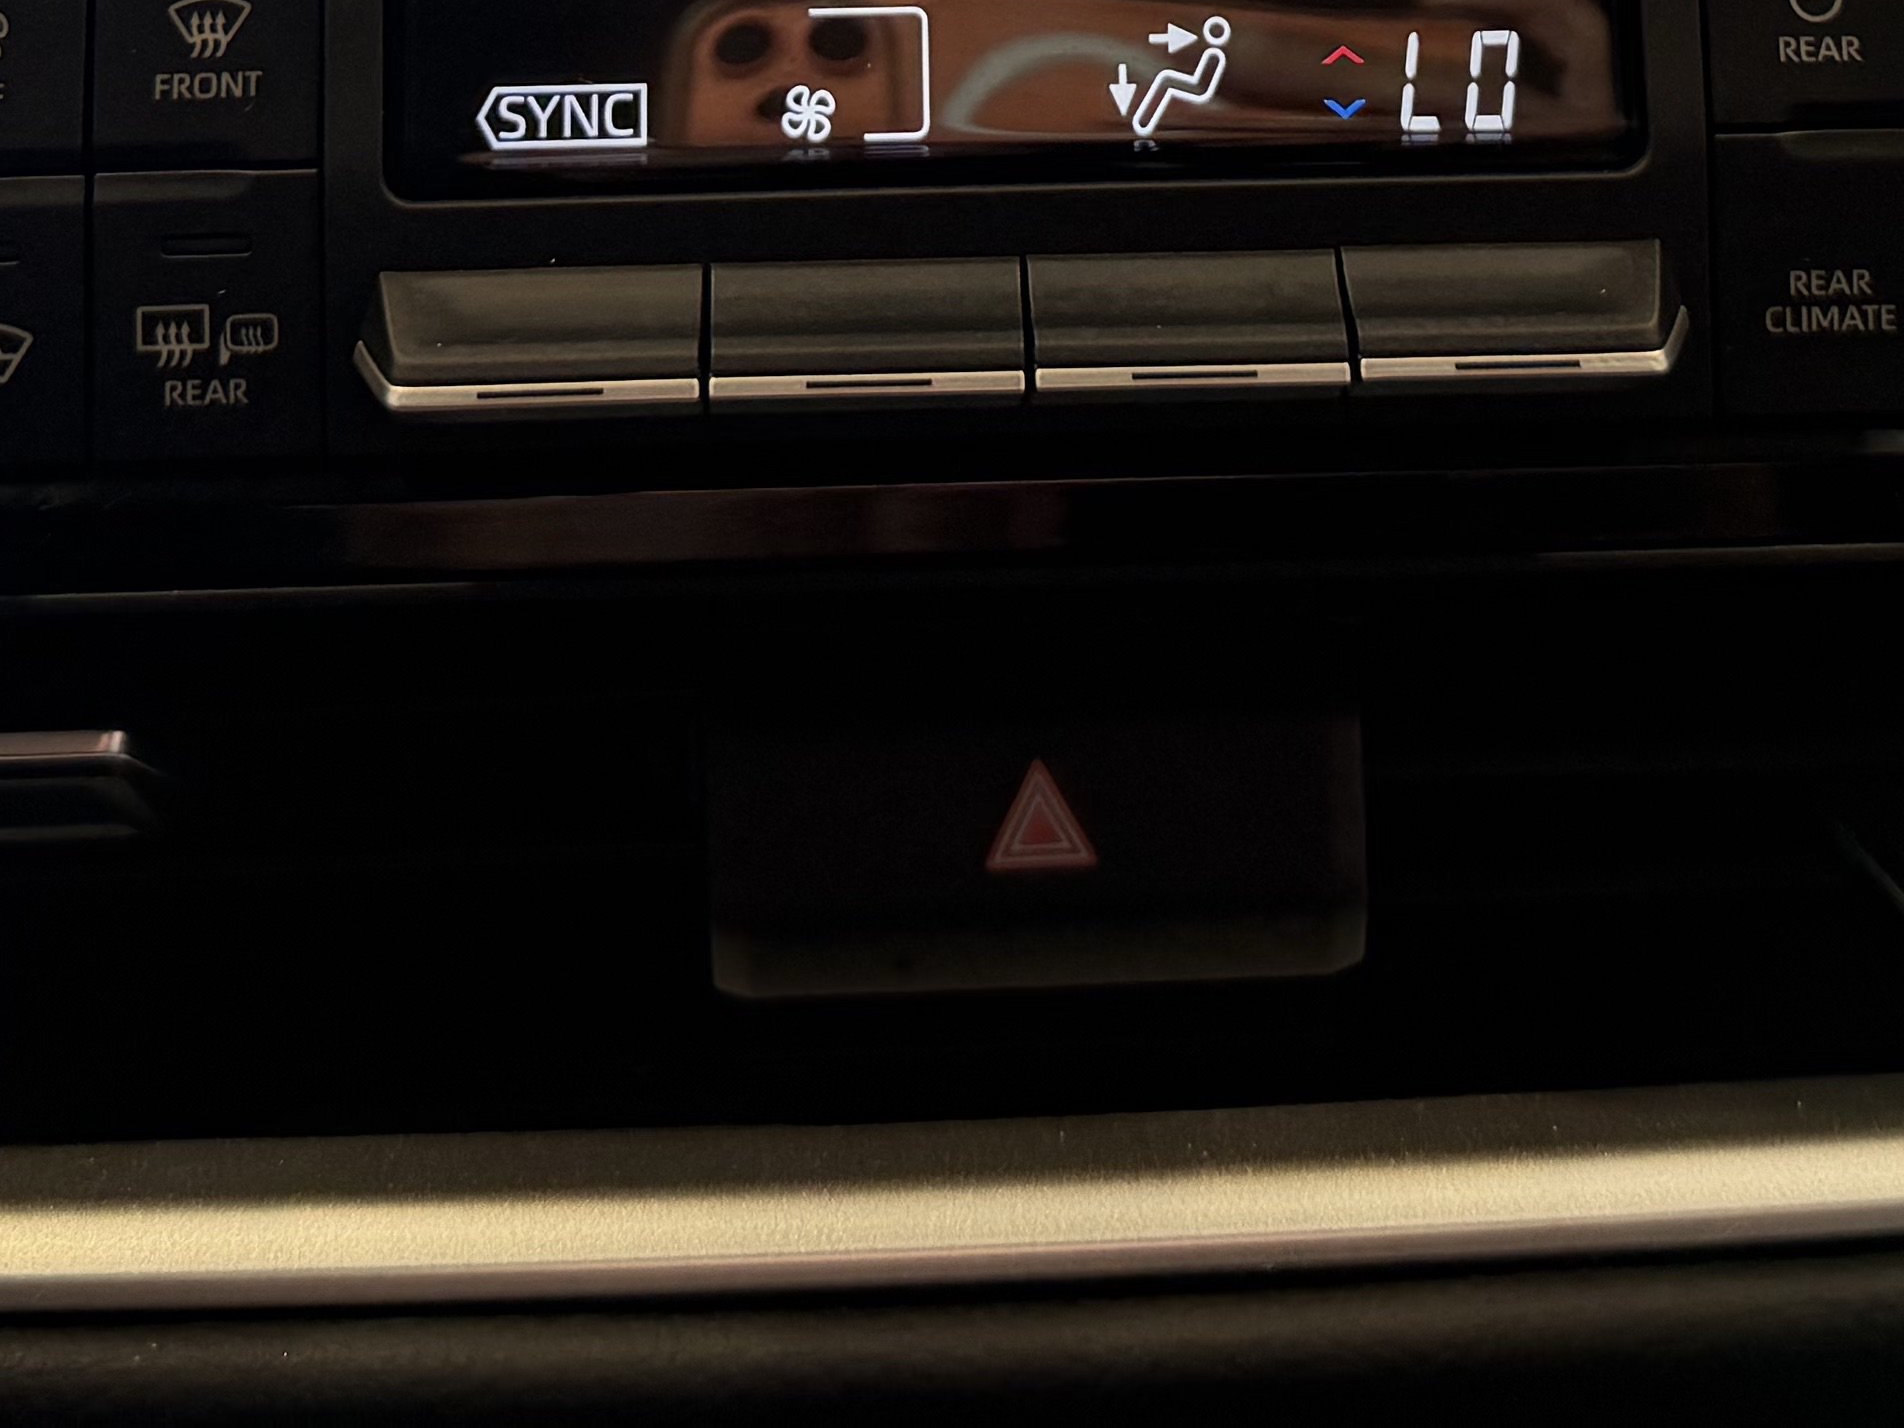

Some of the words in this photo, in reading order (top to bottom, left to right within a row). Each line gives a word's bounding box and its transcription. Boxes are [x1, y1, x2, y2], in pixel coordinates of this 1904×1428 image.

[1778, 35, 1863, 63] REAR
[154, 70, 263, 101] FRONT
[497, 92, 635, 140] SYNC
[1789, 268, 1873, 296] REAR
[1765, 303, 1897, 334] CLIMATE
[163, 378, 249, 407] REAR
